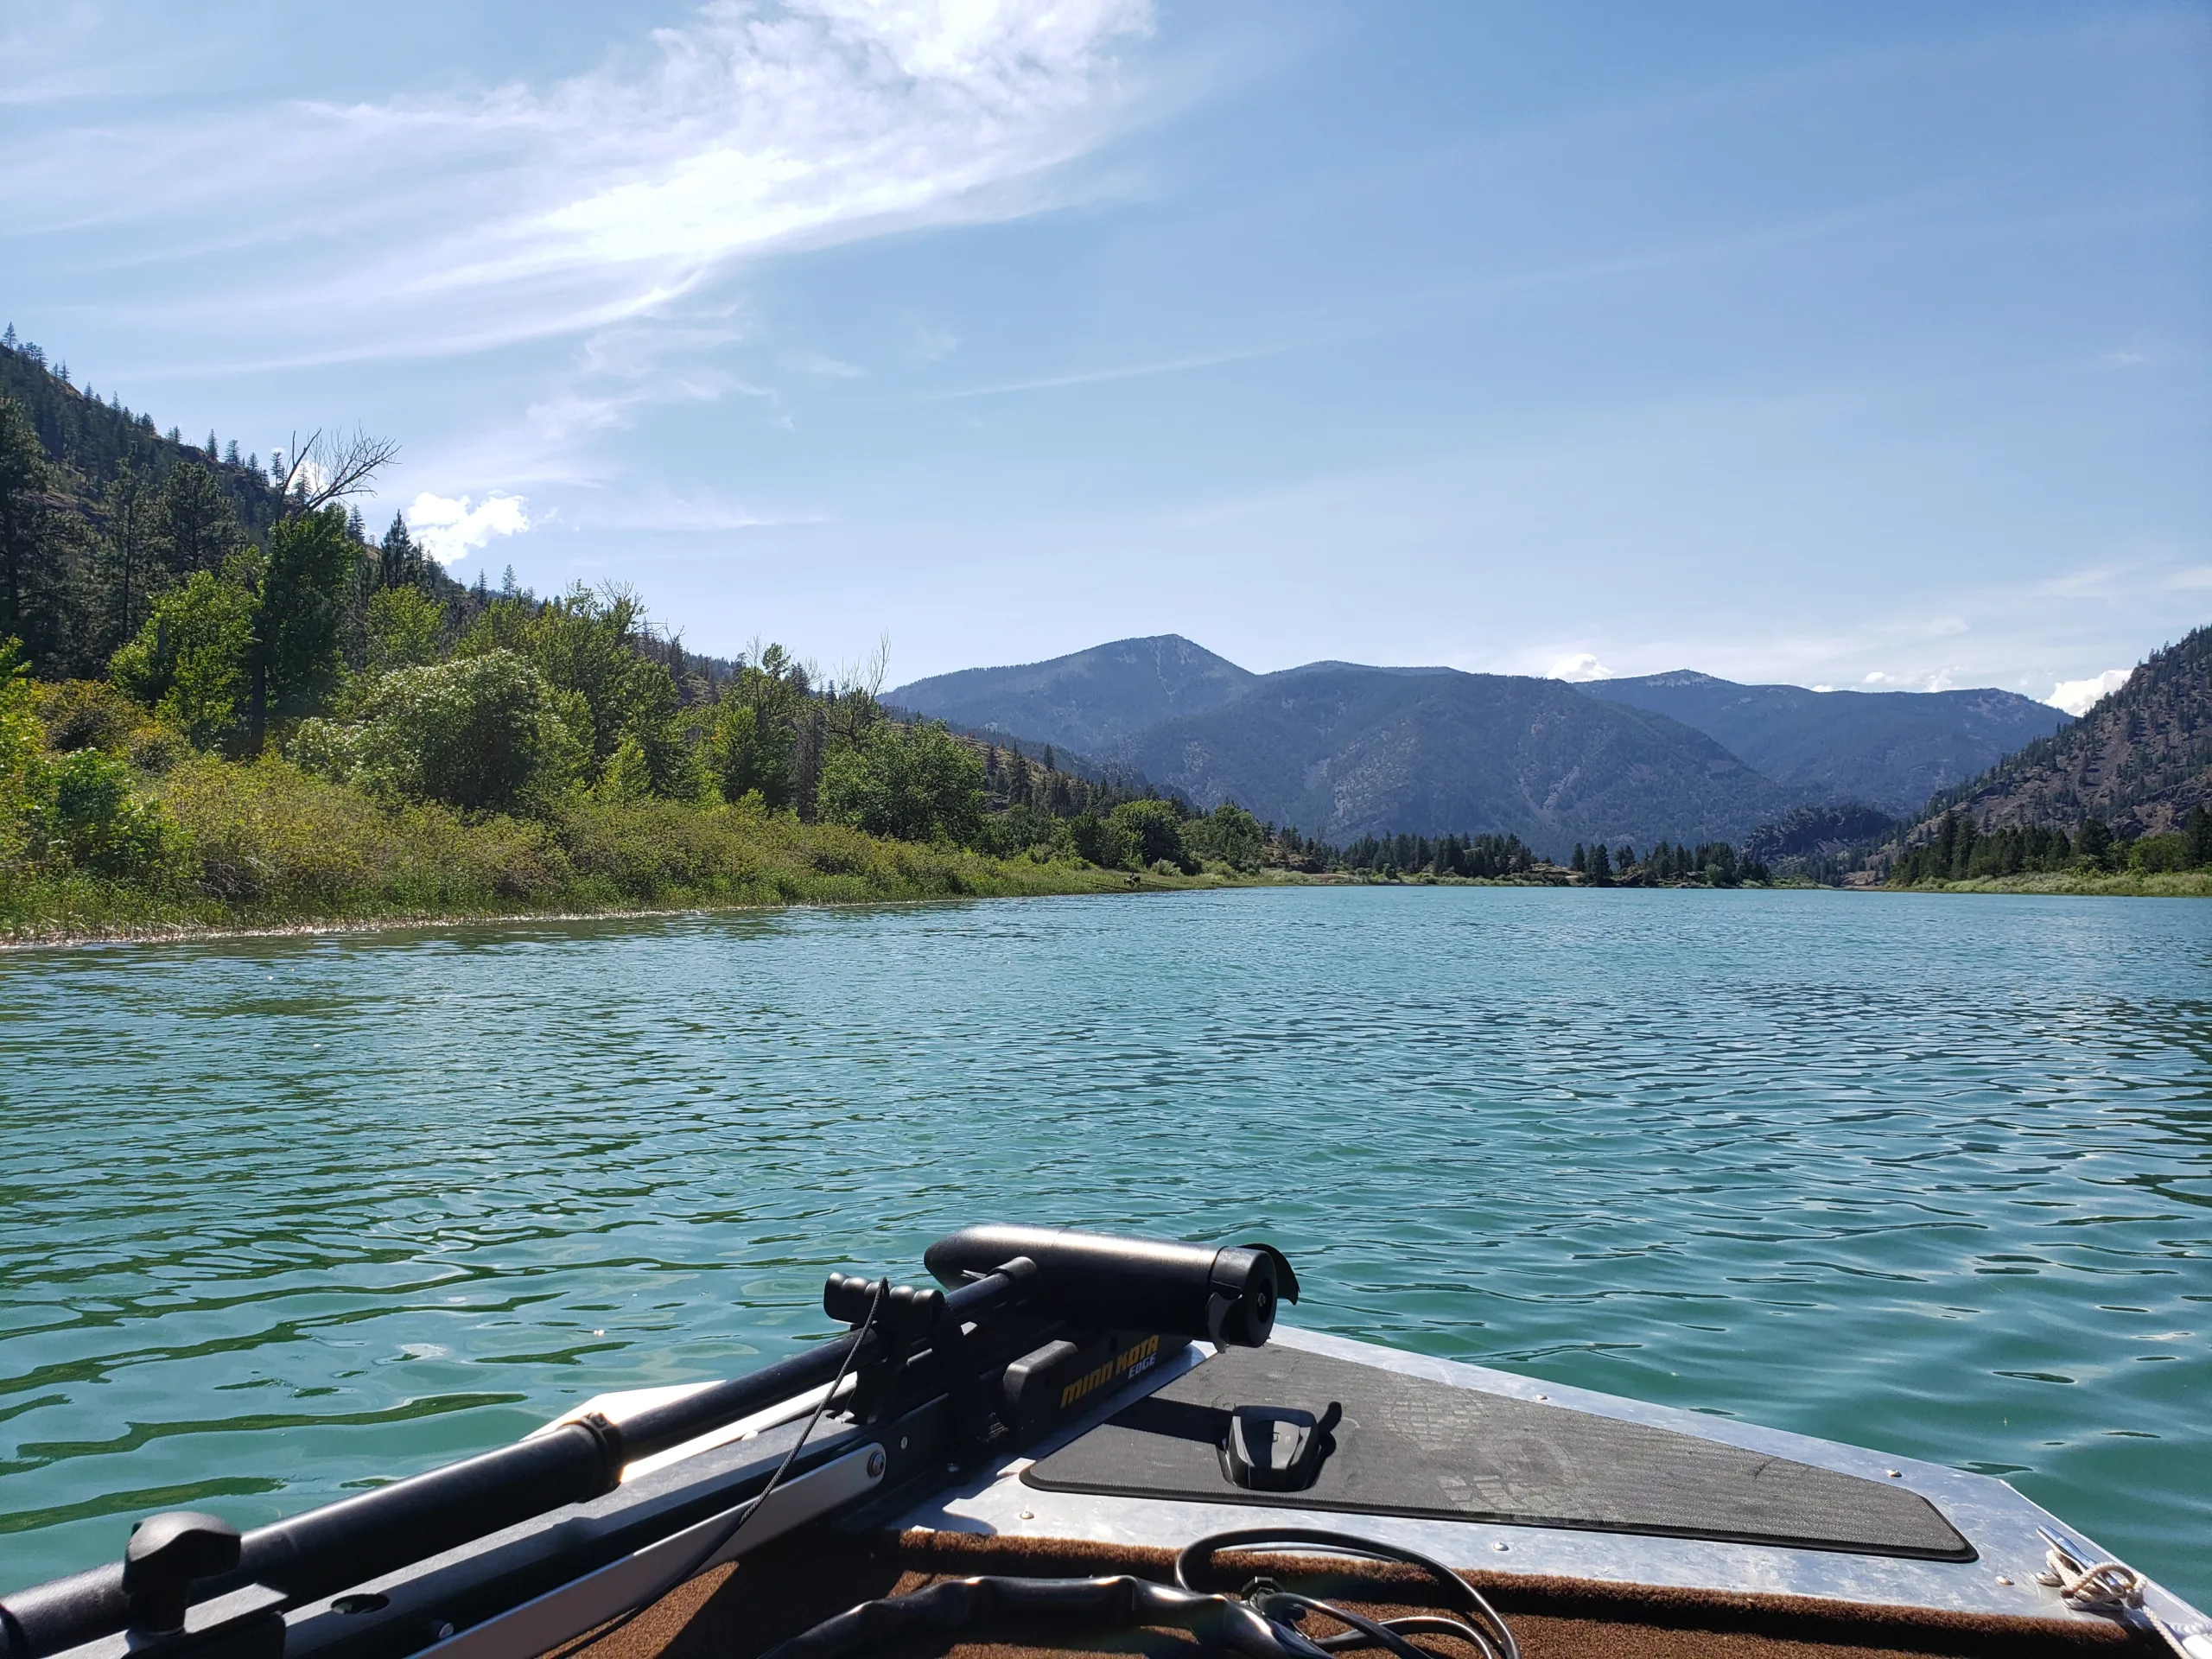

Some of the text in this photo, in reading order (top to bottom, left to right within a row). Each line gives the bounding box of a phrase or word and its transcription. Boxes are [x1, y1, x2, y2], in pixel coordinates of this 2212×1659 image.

[1060, 1334, 1160, 1408] MINN KOTA
[1128, 1351, 1157, 1380] EDGE
